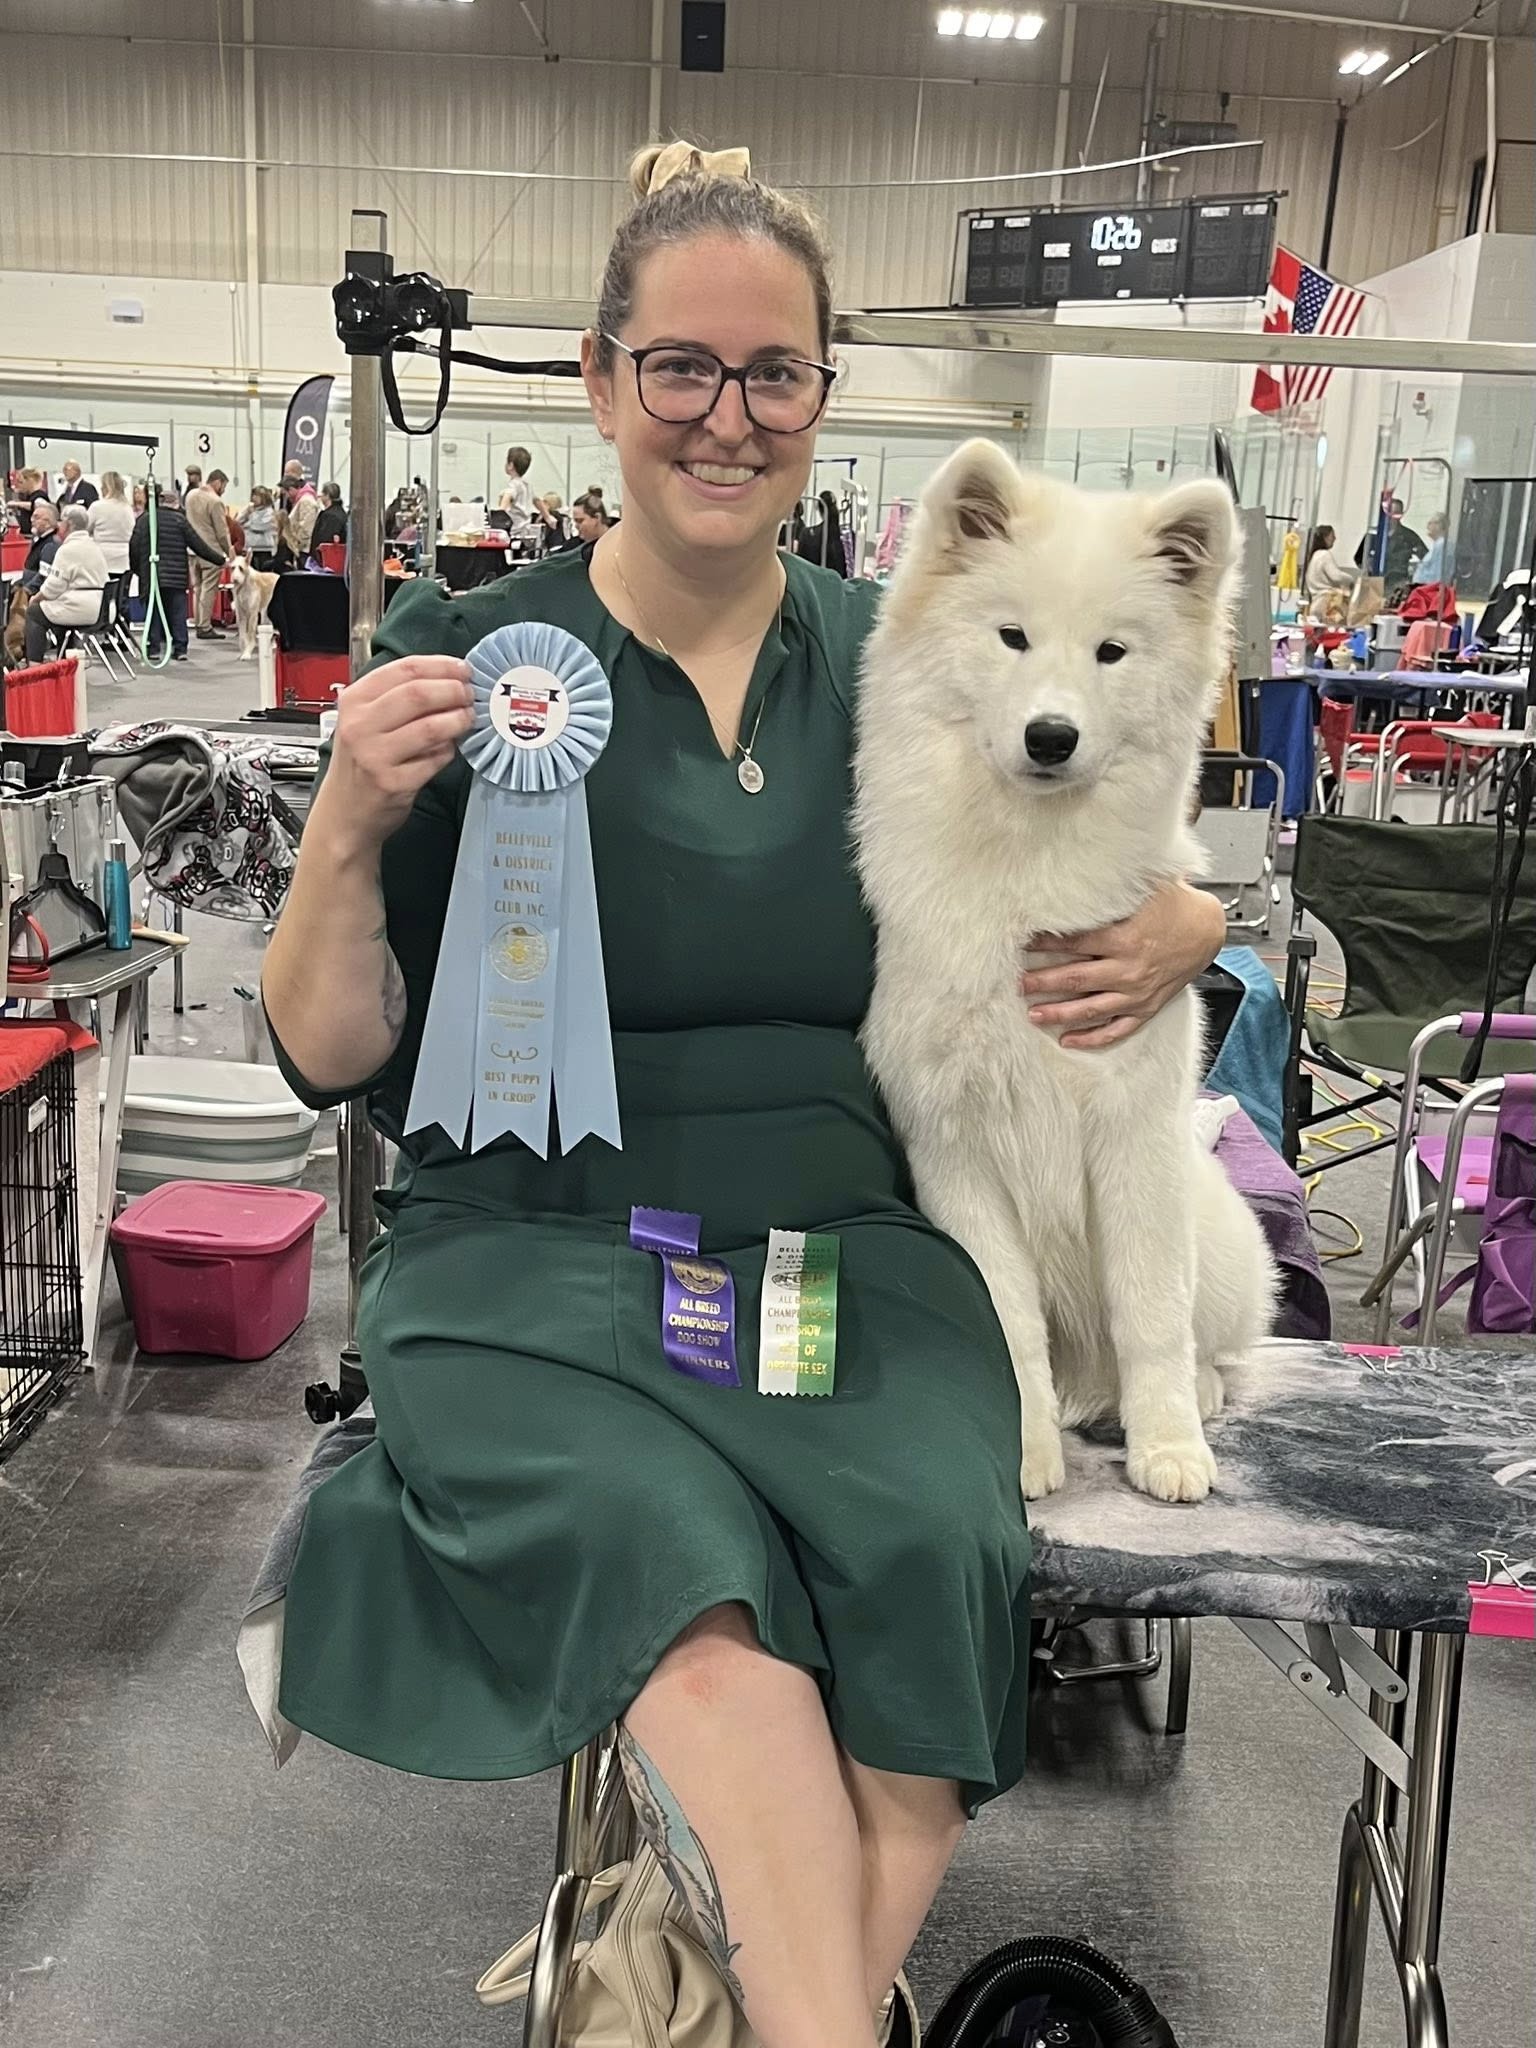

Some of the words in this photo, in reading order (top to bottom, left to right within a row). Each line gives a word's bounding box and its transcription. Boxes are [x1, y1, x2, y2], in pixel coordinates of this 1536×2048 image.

[199, 433, 210, 453] 3
[496, 832, 553, 848] BELLEVILLE
[505, 856, 553, 871] DISTRICT
[503, 879, 542, 894] KENNEL
[494, 900, 521, 914] CLUB
[484, 1071, 506, 1083] BEST
[511, 1073, 541, 1085] PUPPY
[488, 1091, 498, 1101] IN
[502, 1092, 536, 1104] GROUP
[680, 1298, 694, 1311] ALL
[695, 1300, 721, 1315] BREED
[778, 1295, 793, 1304] ALL
[668, 1313, 730, 1333] CHAMPIONSHIP
[677, 1331, 696, 1344] DOG
[697, 1334, 722, 1348] SHOW
[804, 1344, 818, 1356] OF
[811, 1362, 828, 1375] SEX
